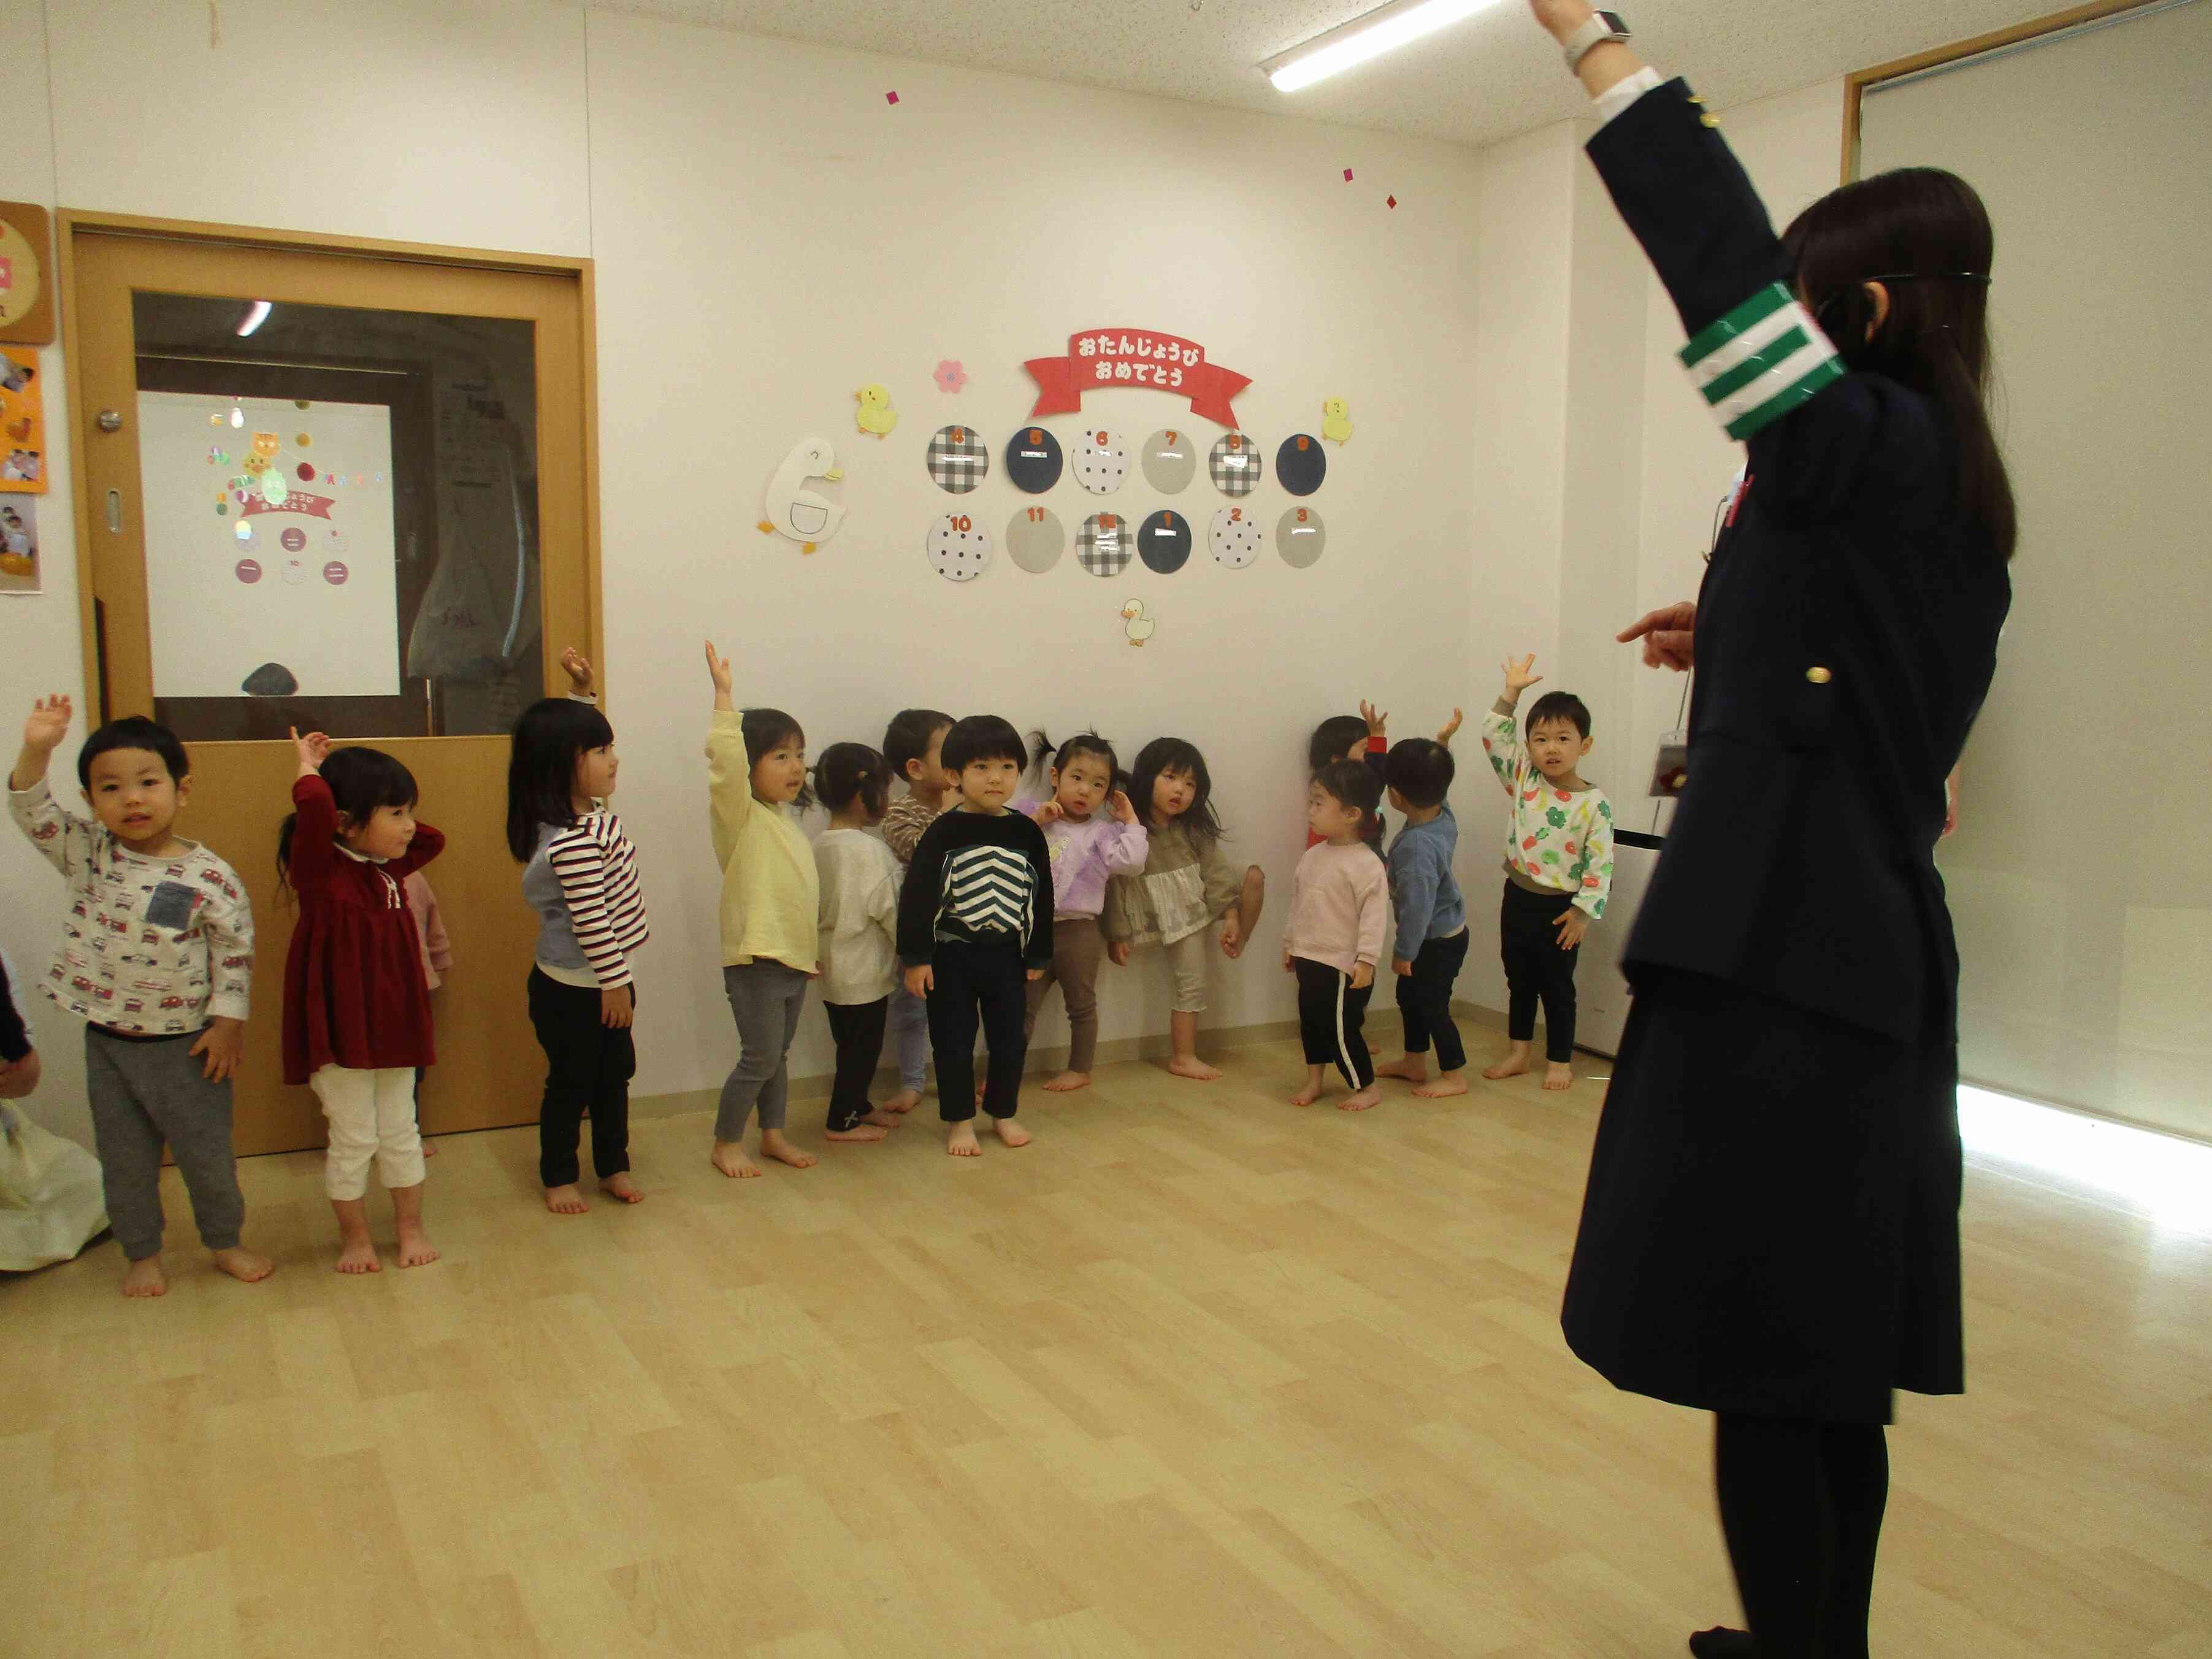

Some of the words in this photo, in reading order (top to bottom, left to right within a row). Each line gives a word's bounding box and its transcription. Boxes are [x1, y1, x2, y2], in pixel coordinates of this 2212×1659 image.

[1079, 335, 1199, 367] おたんじょうび
[1095, 361, 1182, 386] おめでとう
[1096, 431, 1109, 446] 6
[1165, 431, 1178, 445] 7
[1027, 507, 1044, 521] 11
[1163, 511, 1172, 528] 1
[1231, 508, 1242, 521] 2
[1296, 508, 1308, 522] 3
[951, 516, 971, 532] 10
